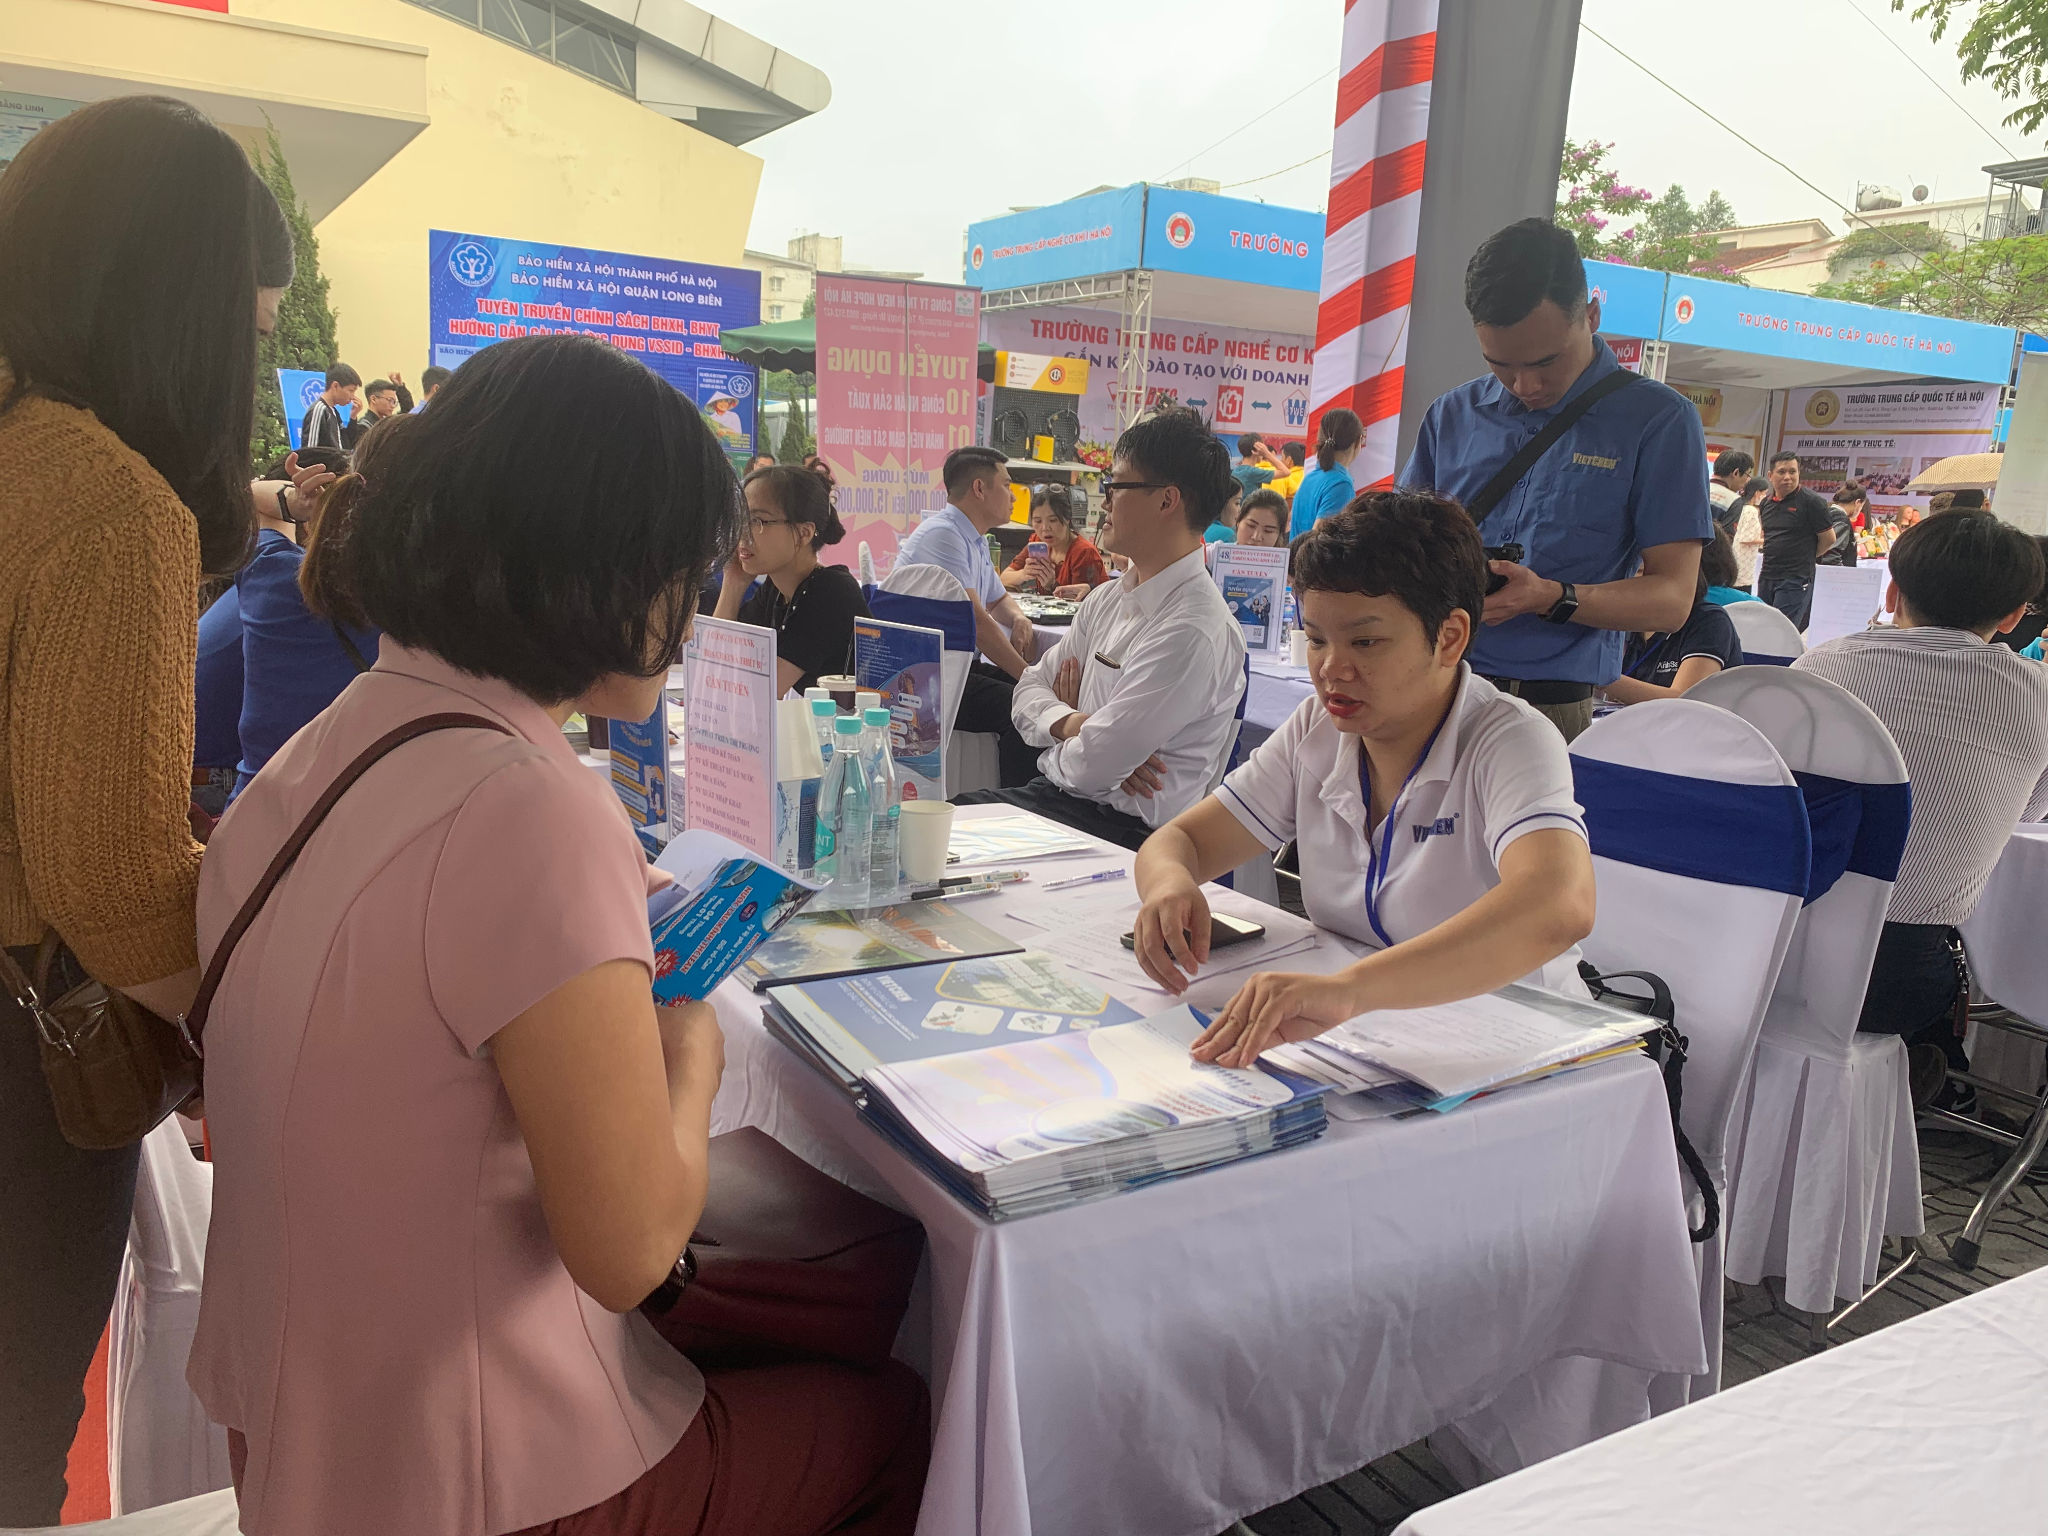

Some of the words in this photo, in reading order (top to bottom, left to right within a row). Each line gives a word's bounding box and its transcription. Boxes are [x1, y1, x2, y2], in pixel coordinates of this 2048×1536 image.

[992, 246, 1014, 260] TRƯỜNG
[1015, 243, 1033, 255] TRUNG
[1090, 227, 1100, 240] HÀ
[1100, 224, 1113, 240] NỘI
[1230, 230, 1309, 258] TRƯỜNG
[518, 254, 543, 267] BẢO
[545, 256, 572, 271] HIỂM
[576, 261, 591, 273] XÃ
[595, 264, 614, 278] HỘI
[617, 266, 652, 281] THÀNH
[656, 271, 679, 284] PHỐ
[681, 274, 696, 286] HÀ
[698, 276, 717, 290] NỘI
[511, 271, 539, 286] BẢO
[543, 273, 573, 290] HIỂM
[577, 279, 594, 292] XÃ
[598, 281, 620, 297] HỘI
[624, 285, 659, 301] QUẬN
[662, 292, 695, 303] LONG
[698, 294, 722, 307] BIÊN
[476, 297, 519, 316] TUYÊN
[574, 307, 614, 326] CHÍNH
[616, 311, 649, 329] SÁCH
[651, 315, 688, 336] BHXH,
[690, 321, 720, 339] BHYT
[449, 319, 495, 338] HƯỚNG
[648, 337, 684, 356] VSSID
[694, 343, 726, 360] BHXH
[1030, 319, 1109, 345] TRƯỜNG
[1182, 331, 1218, 355] CẤP
[1224, 338, 1271, 361] NGHỀ
[1276, 345, 1300, 364] CƠ
[1738, 312, 1789, 332] TRƯỜNG
[1794, 320, 1833, 338] TRUNG
[1837, 324, 1862, 342] CẤP
[1865, 330, 1898, 348] QUỐC
[1902, 334, 1916, 349] TẾ
[1918, 338, 1933, 352] HÀ
[1937, 341, 1957, 358] NỘI
[439, 347, 454, 355] BẢO
[1616, 344, 1634, 361] NỘI
[1183, 362, 1216, 380] TẠO
[1220, 364, 1247, 381] VỚI
[1252, 370, 1309, 386] DOANH
[1692, 394, 1702, 405] HÀ
[1703, 396, 1716, 407] NỘI
[1846, 392, 1876, 404] TRƯỜNG
[1877, 393, 1903, 404] TRUNG
[1904, 390, 1919, 403] CẤP
[1921, 390, 1944, 403] QUỐC
[1945, 391, 1955, 402] TẾ
[1956, 391, 1968, 402] HÀ
[1970, 391, 1985, 402] NỘI
[1816, 438, 1829, 447] ẢNH
[1831, 440, 1846, 448] HỌC
[1848, 439, 1861, 447] TẬP
[1863, 440, 1882, 448] THỰC
[1219, 551, 1230, 559] 48
[743, 637, 754, 648] XNK
[740, 656, 756, 668] THIẾT
[756, 660, 763, 671] BỊ
[706, 674, 721, 690] CẦN
[722, 679, 749, 697] TUYỂN
[702, 817, 715, 829] KINH
[714, 823, 731, 837] DOANH
[730, 883, 754, 910] NƯỚC
[695, 906, 706, 918] 01
[701, 907, 715, 922] 04
[719, 905, 736, 923] LAU
[704, 919, 725, 943] KÍNH
[678, 939, 709, 975] THCLEAN
[699, 956, 713, 971] Can
